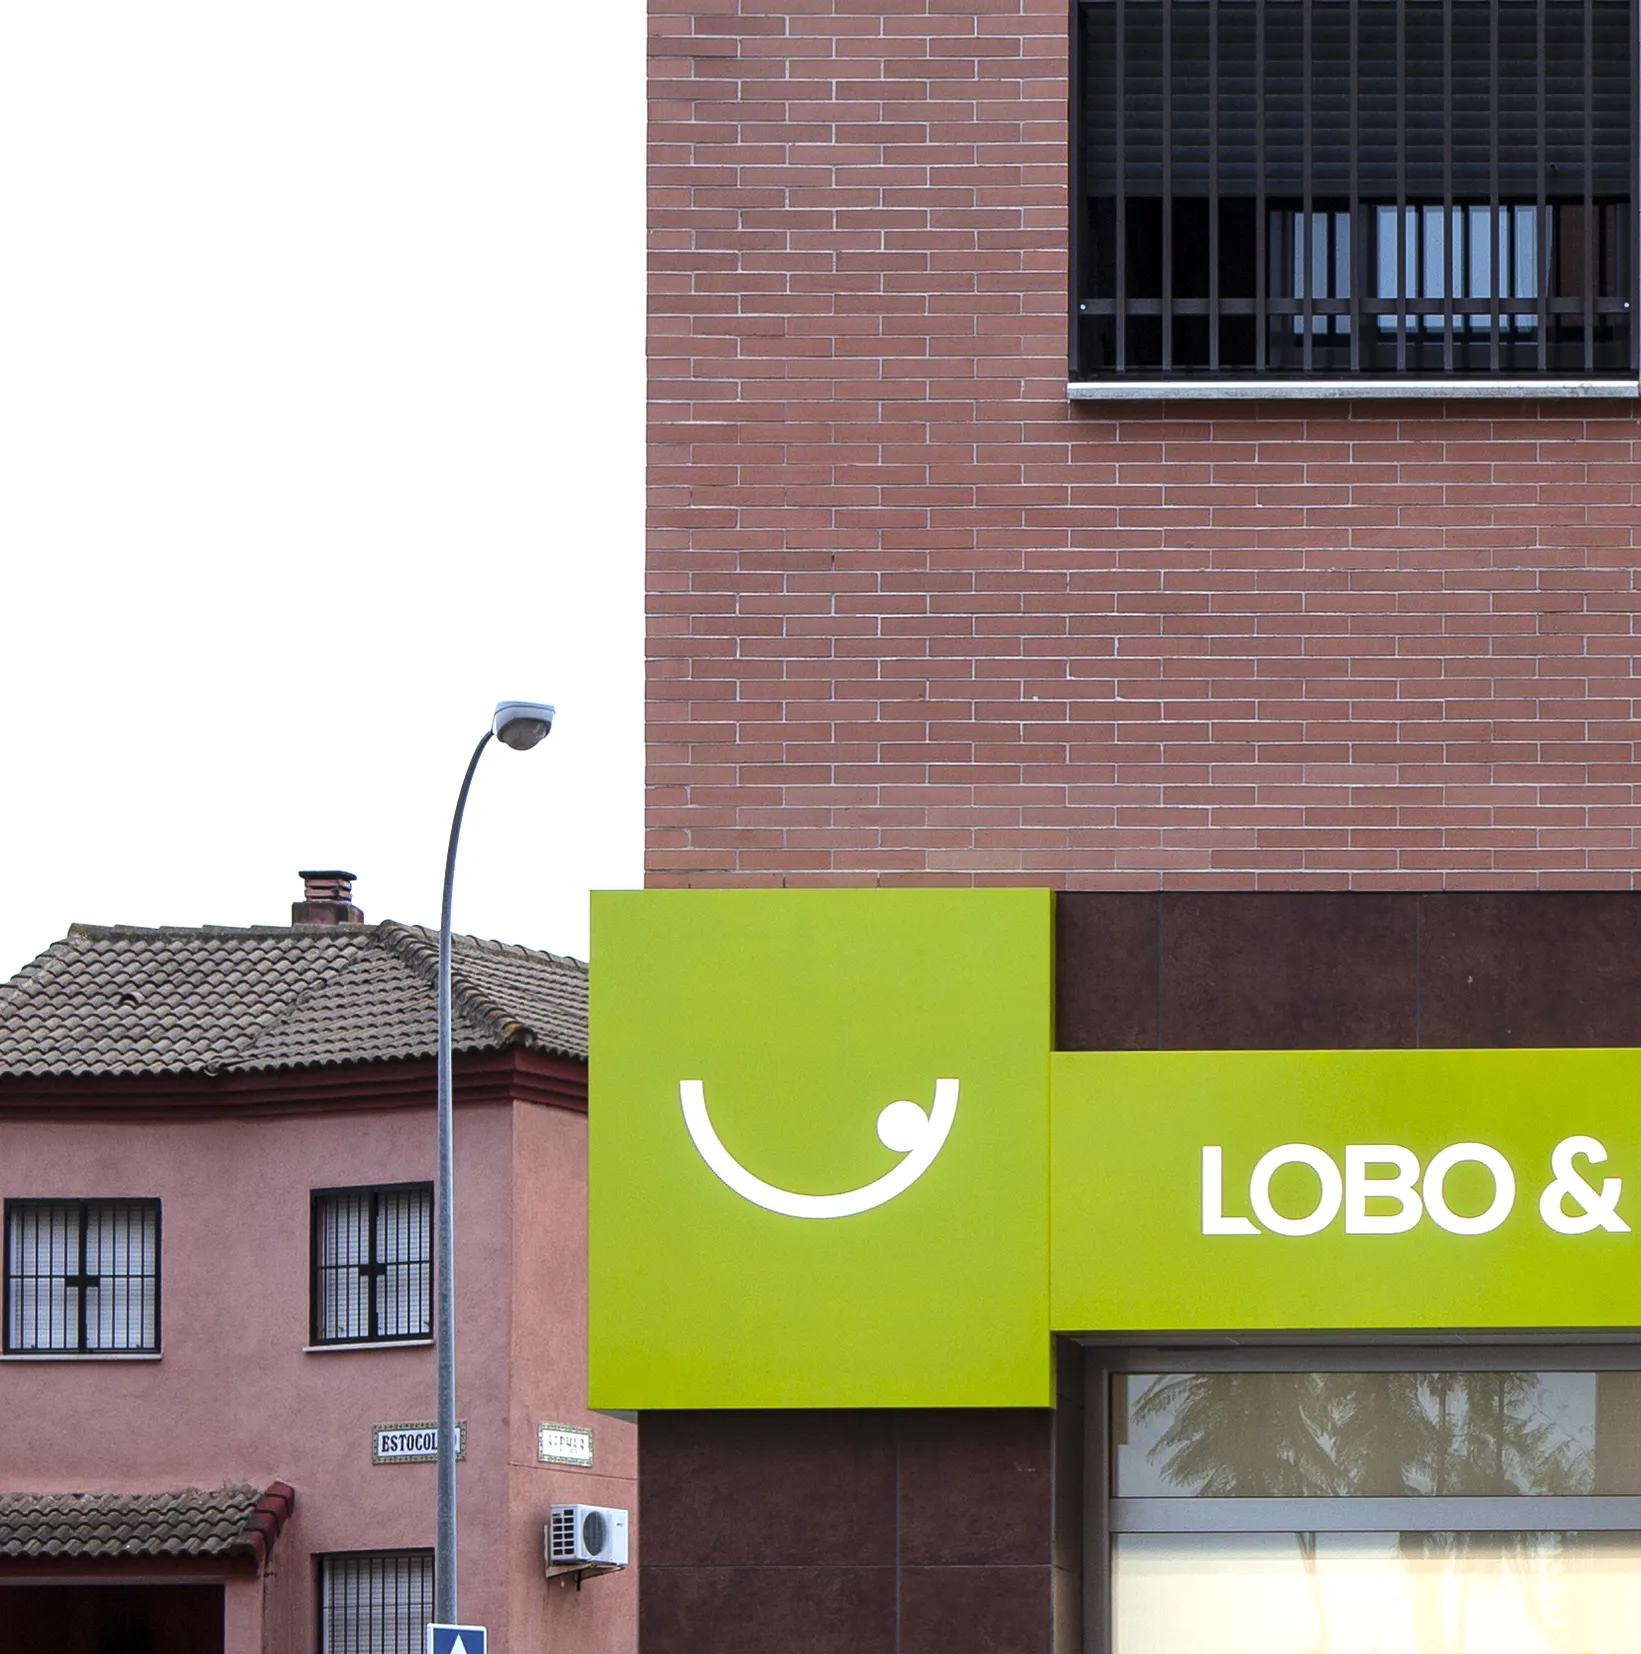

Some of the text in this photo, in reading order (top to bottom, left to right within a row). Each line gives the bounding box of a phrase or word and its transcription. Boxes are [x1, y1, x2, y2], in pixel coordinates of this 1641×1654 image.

[1202, 1144, 1517, 1238] LOBO
[1539, 1136, 1633, 1236] &
[381, 1432, 458, 1452] ESTOCOL
